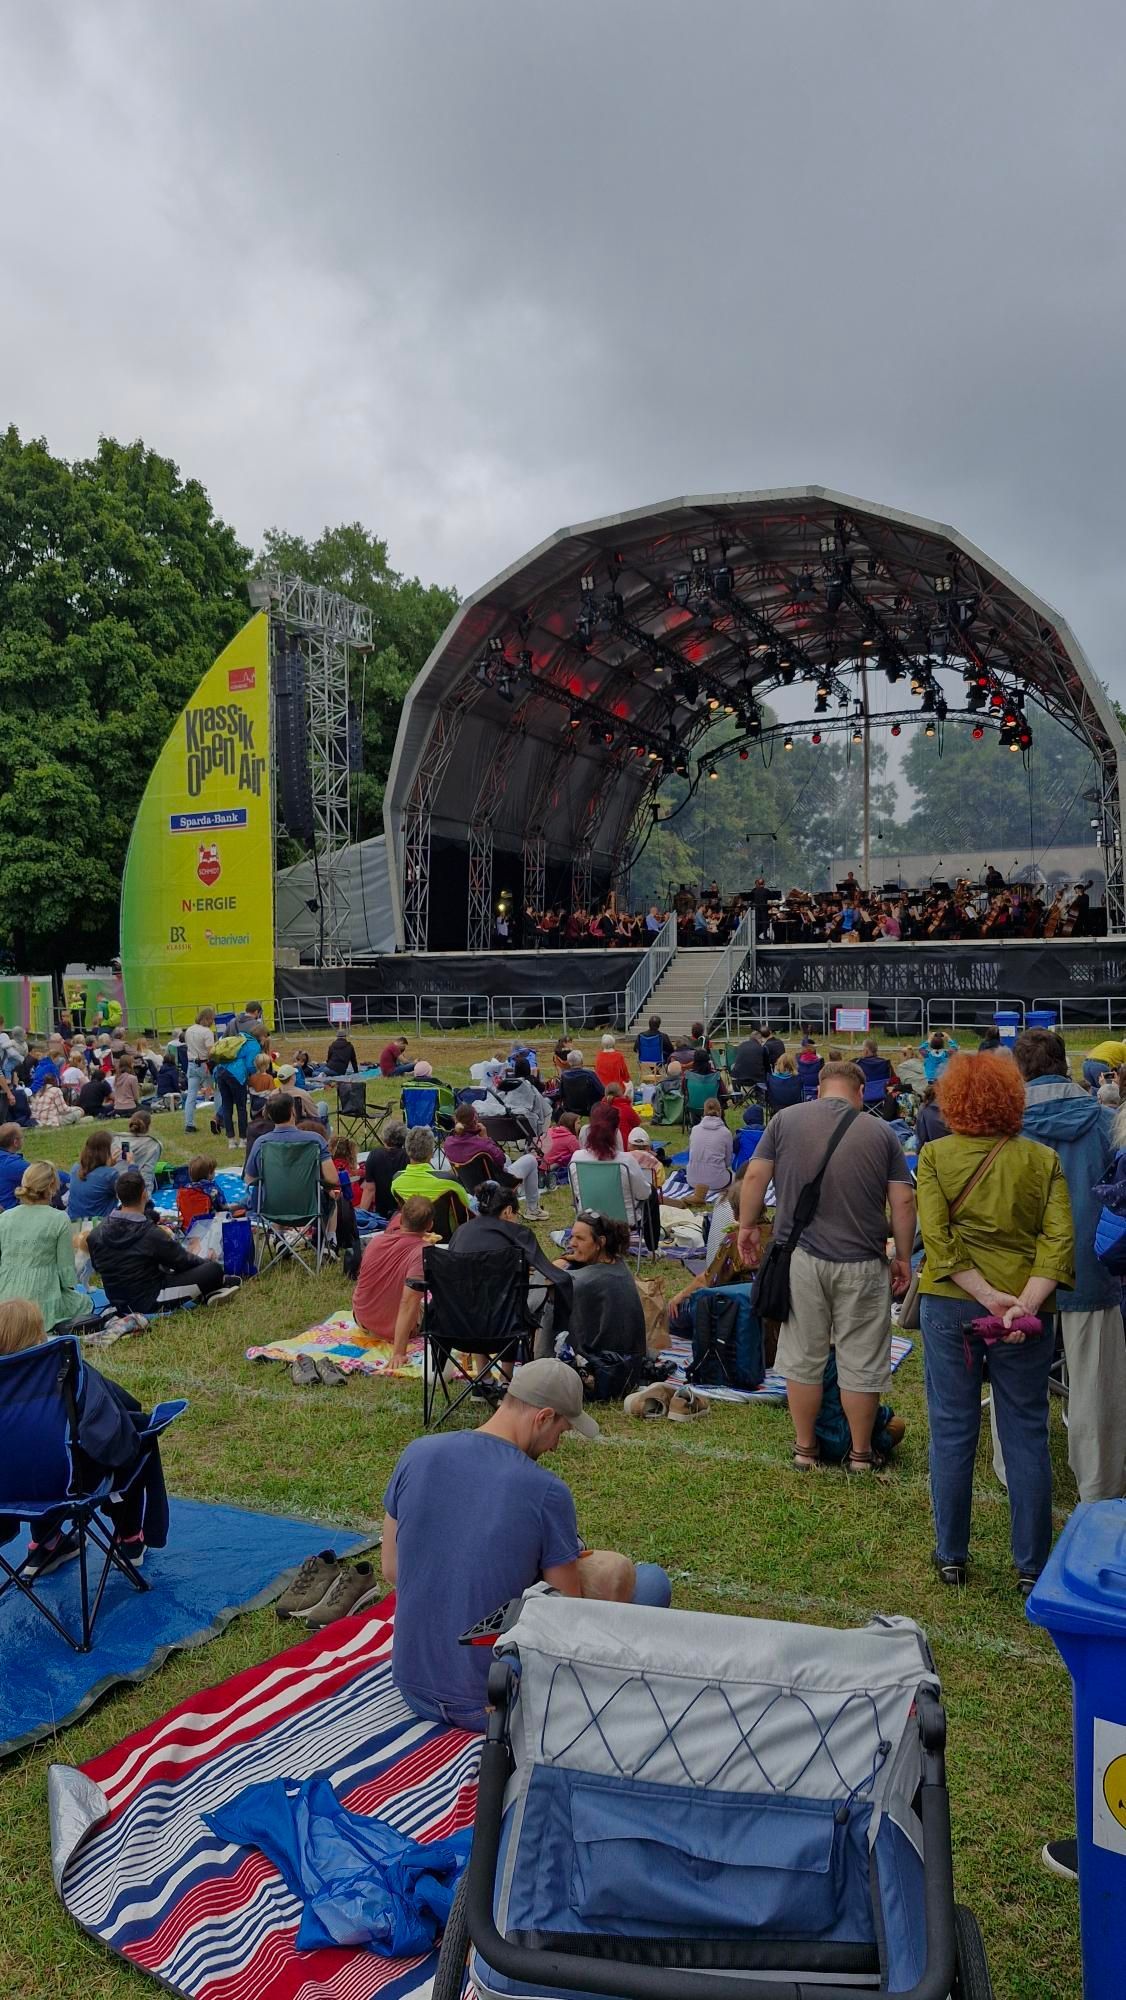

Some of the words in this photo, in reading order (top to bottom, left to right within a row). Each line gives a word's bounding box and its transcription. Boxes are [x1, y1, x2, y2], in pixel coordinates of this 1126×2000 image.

[185, 704, 254, 753] Klassik
[187, 733, 235, 796] Open
[238, 752, 265, 797] Air
[180, 812, 239, 829] Sparda-Bank
[170, 926, 186, 943] BR
[208, 932, 249, 946] charivari
